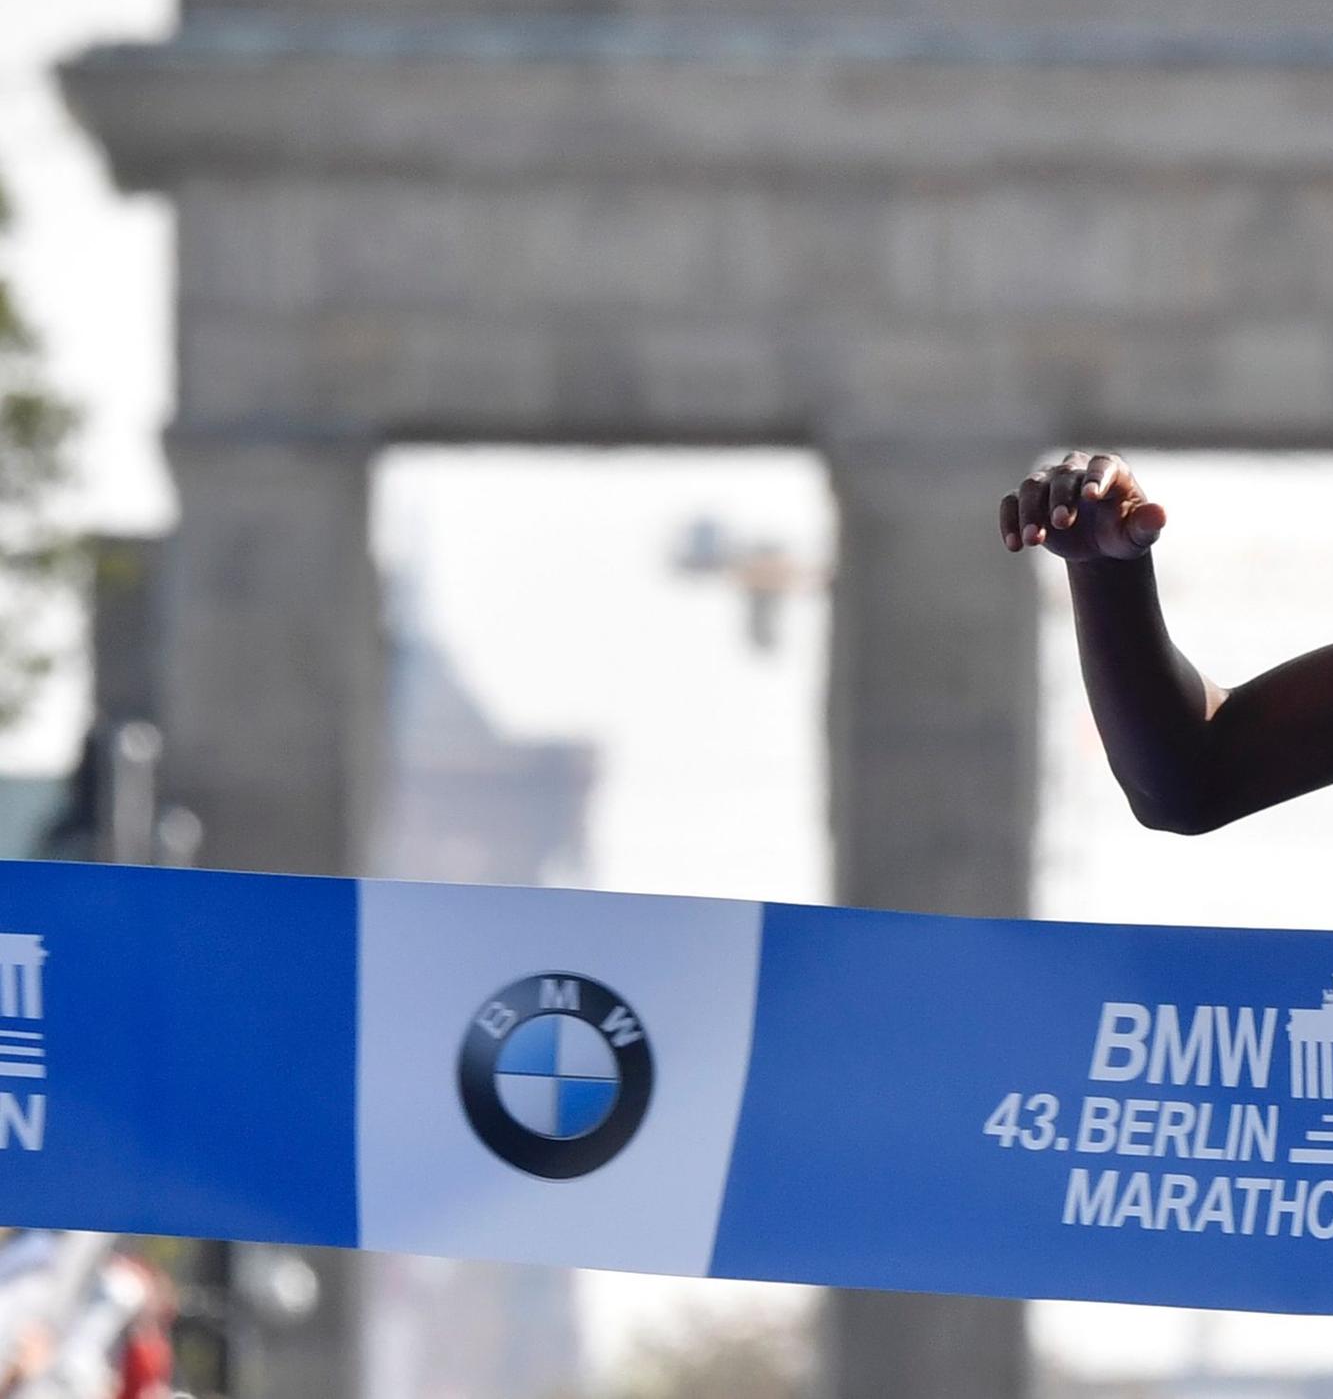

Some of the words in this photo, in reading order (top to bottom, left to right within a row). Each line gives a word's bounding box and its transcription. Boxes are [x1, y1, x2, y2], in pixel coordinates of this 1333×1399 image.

[476, 978, 643, 1048] BMW
[1089, 1001, 1278, 1089] BMW
[983, 1091, 1070, 1151] 43.
[1075, 1096, 1278, 1163] BERLIN
